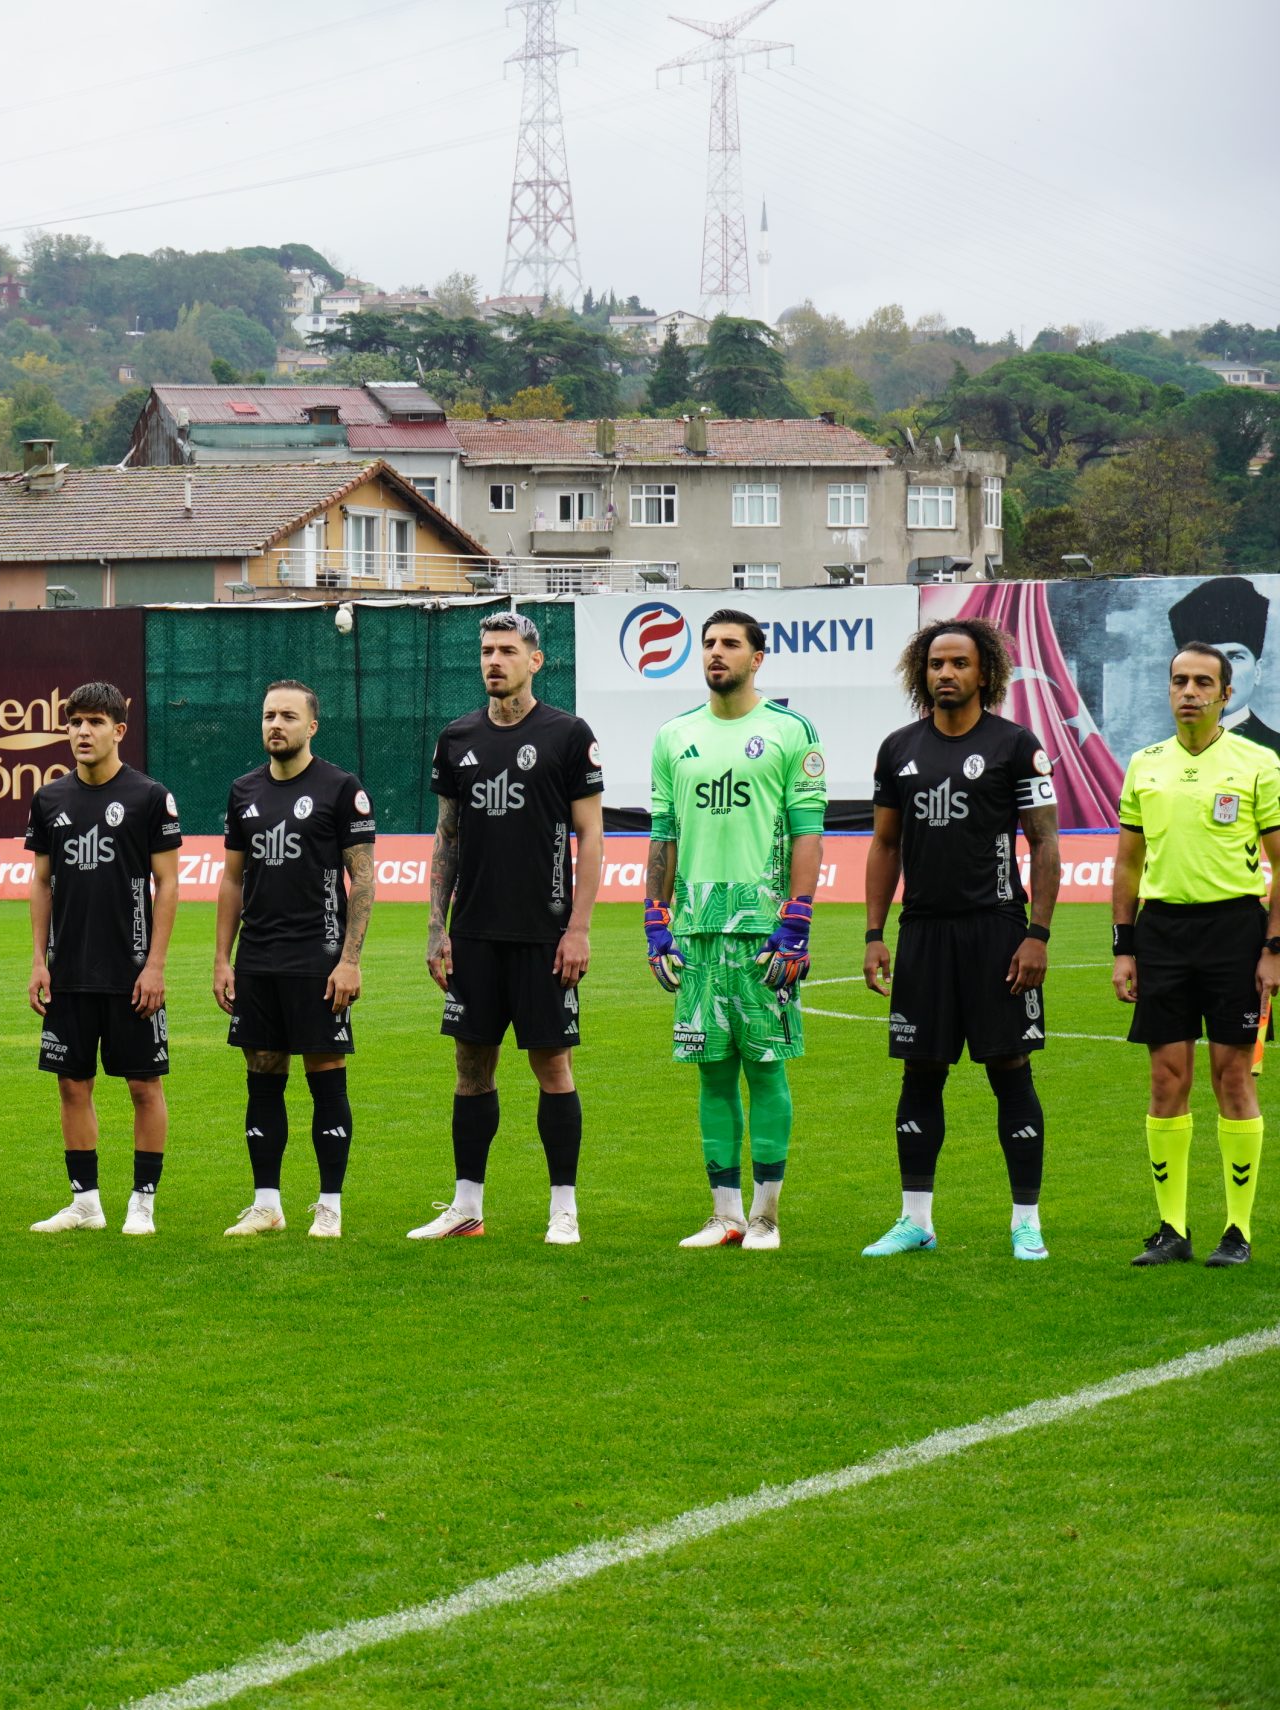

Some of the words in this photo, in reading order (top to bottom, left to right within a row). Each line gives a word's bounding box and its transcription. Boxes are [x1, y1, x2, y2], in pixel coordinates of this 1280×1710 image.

[1038, 781, 1052, 799] C
[487, 808, 507, 816] GRUP
[711, 808, 732, 816] GRUP
[929, 819, 950, 827] GRUP
[552, 823, 563, 898] INTRALINE
[771, 815, 780, 890] INTRALINE
[79, 862, 98, 871] GRUP
[996, 834, 1008, 903] NTRALINE
[132, 878, 142, 950] INTRALINE
[564, 988, 578, 1014] 4
[150, 1008, 168, 1043] 19
[896, 1035, 914, 1043] KOLA
[46, 1053, 64, 1061] KOLA
